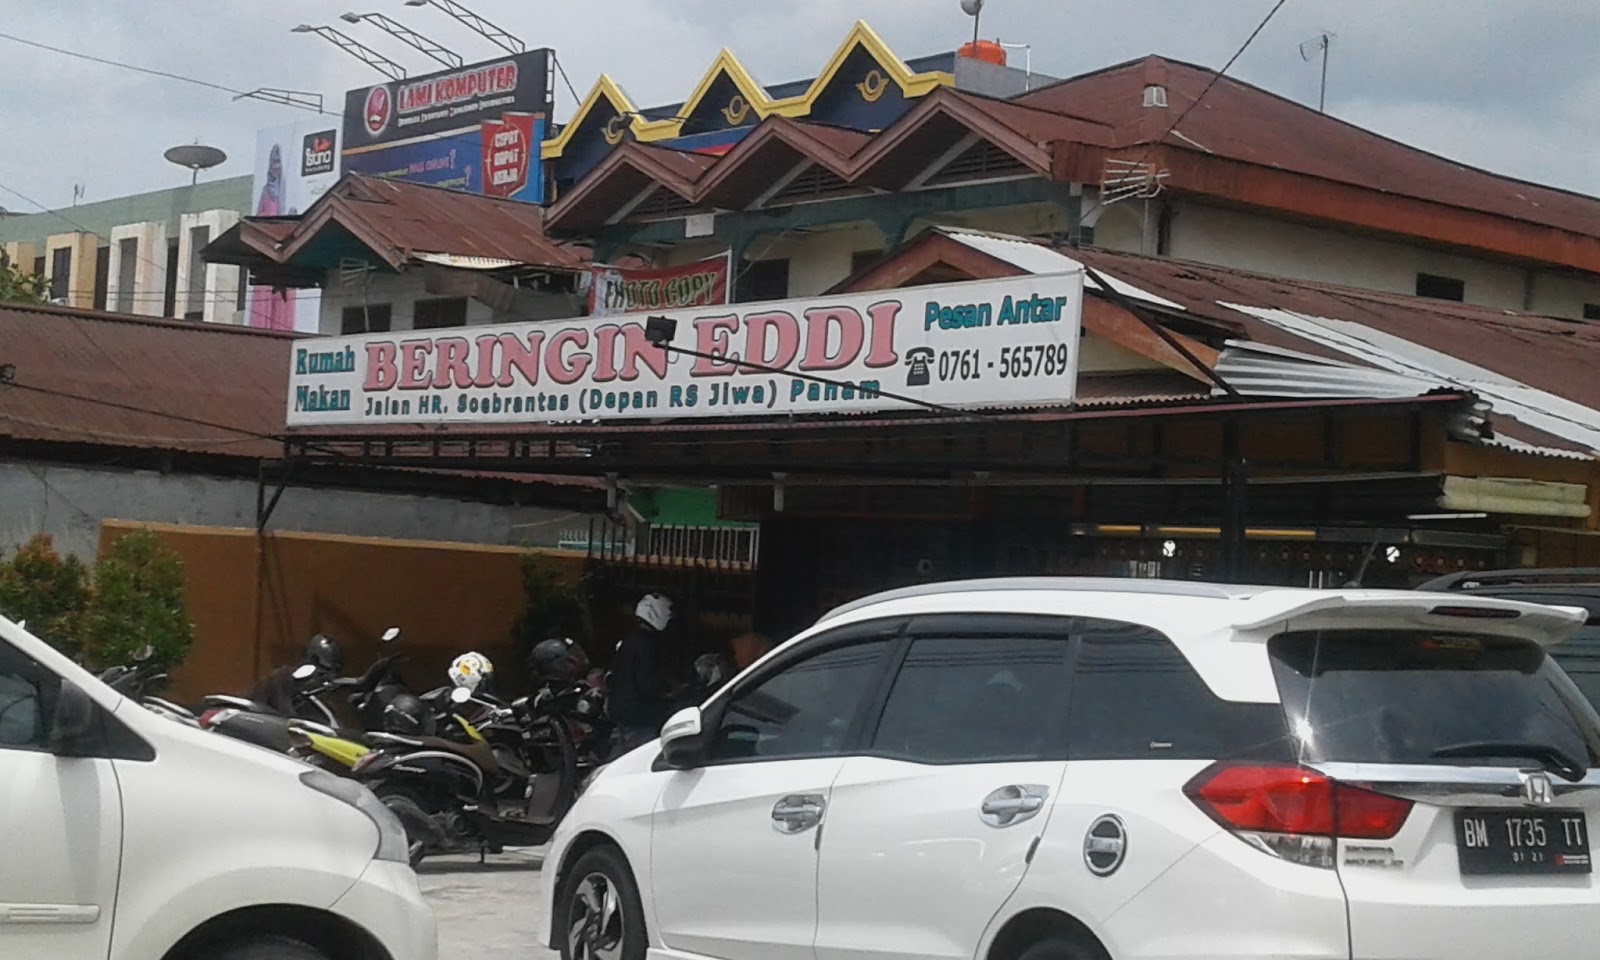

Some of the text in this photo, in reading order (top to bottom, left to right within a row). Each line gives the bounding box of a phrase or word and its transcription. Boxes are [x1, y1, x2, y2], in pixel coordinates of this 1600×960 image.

[435, 63, 517, 104] KOMPUTER
[664, 272, 718, 308] COPY
[924, 293, 1068, 332] Pesan Antar
[295, 346, 355, 375] Rumah
[362, 299, 903, 393] BERINGIN EDDI
[938, 349, 981, 382] 0761
[999, 342, 1068, 379] 565789
[294, 384, 351, 413] Makan
[365, 396, 411, 416] Jalan
[457, 391, 569, 414] Soebrantas
[579, 388, 658, 414] (Depan
[670, 384, 699, 407] RS
[709, 379, 777, 408] Jiwa)
[790, 379, 880, 402] Panam
[1463, 818, 1583, 848] BM 1735 TT
